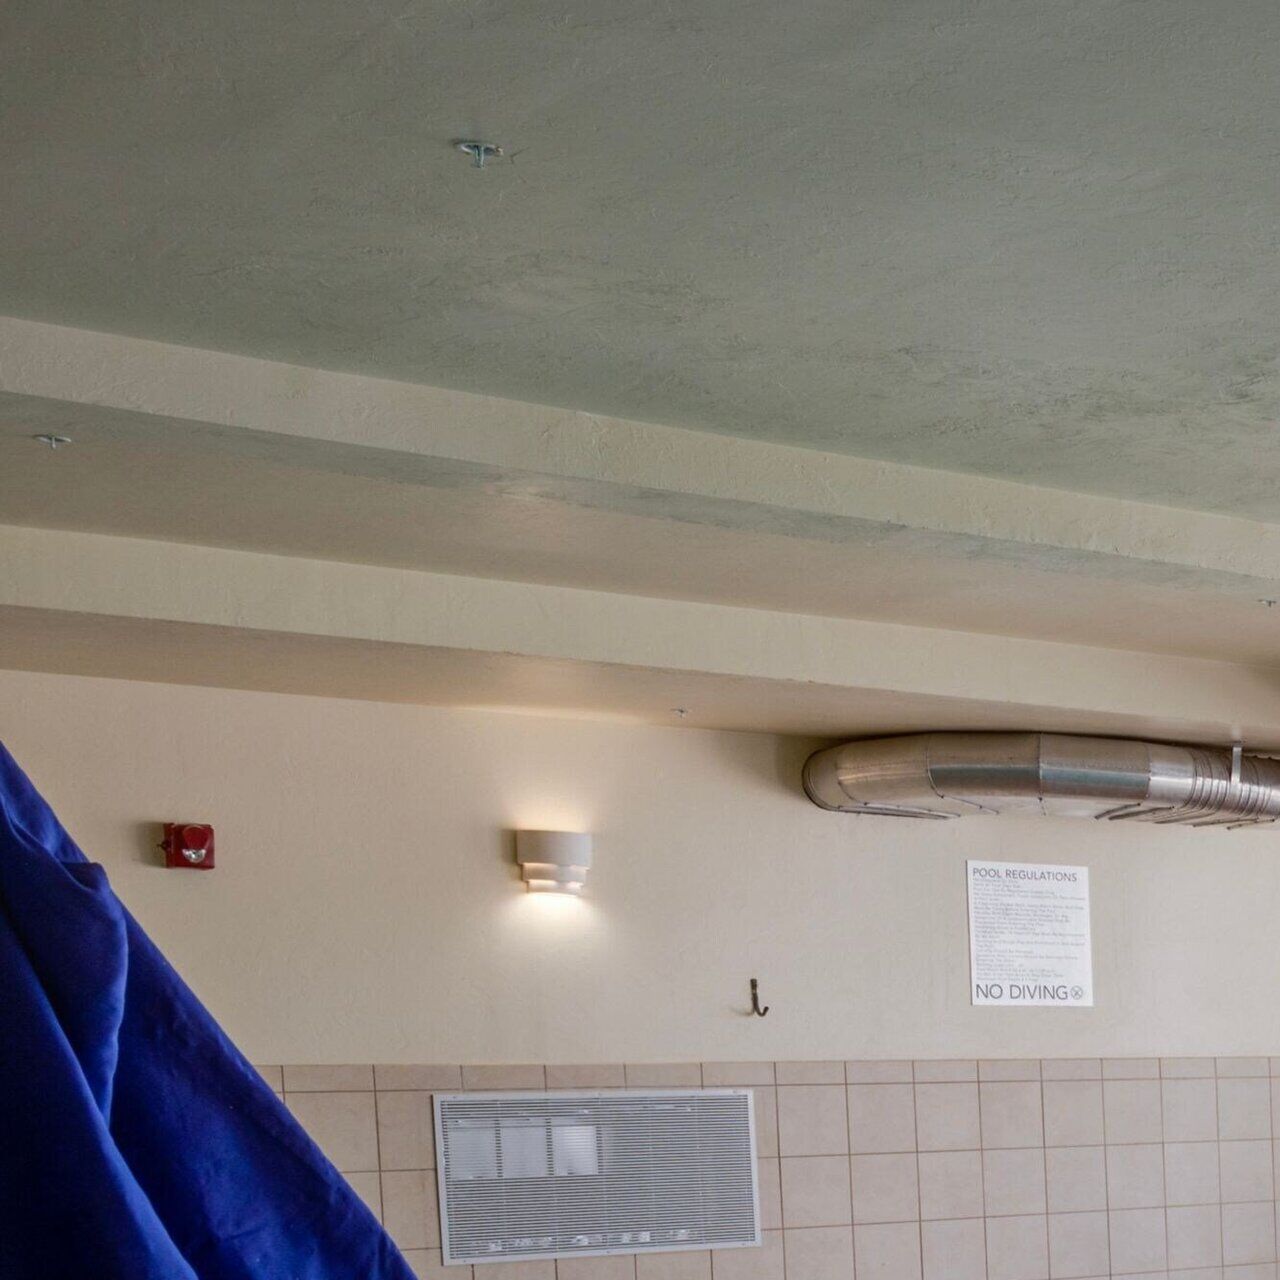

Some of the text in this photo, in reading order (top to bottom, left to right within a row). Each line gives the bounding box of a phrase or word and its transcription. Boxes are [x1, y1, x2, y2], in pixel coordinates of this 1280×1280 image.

[973, 868, 1078, 882] POOL REGULATIONS
[976, 984, 1068, 1000] NO DIVING
